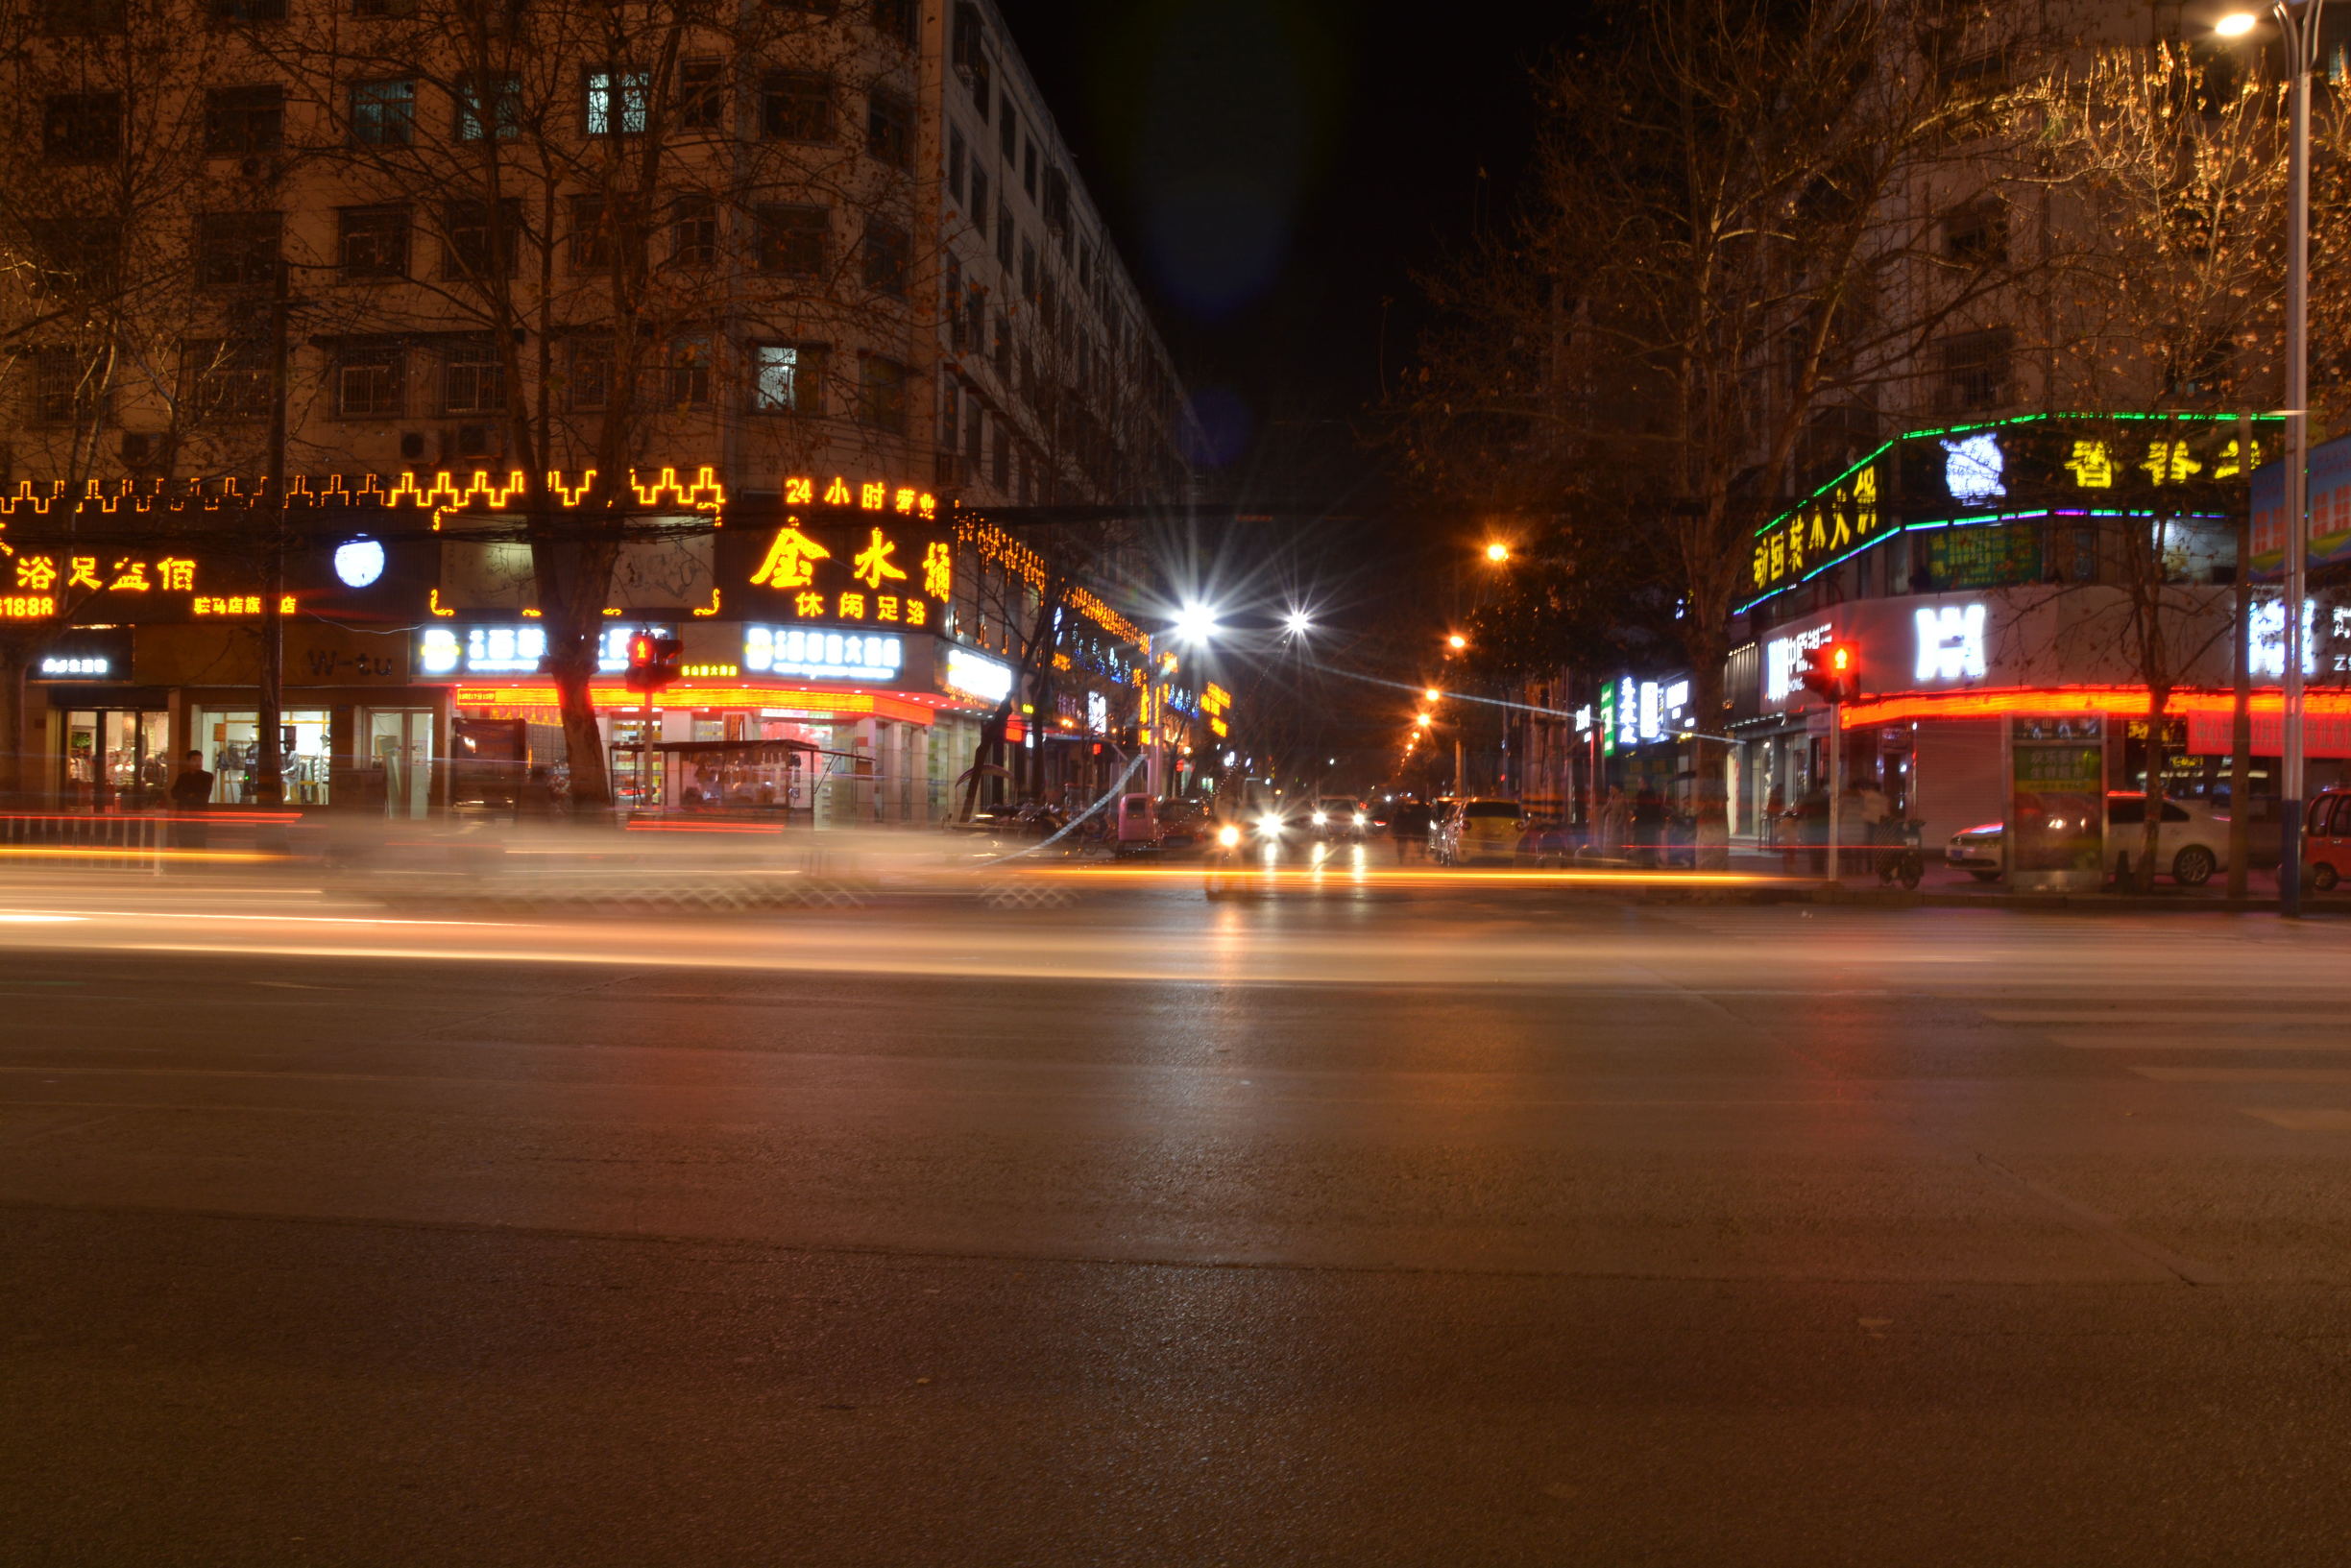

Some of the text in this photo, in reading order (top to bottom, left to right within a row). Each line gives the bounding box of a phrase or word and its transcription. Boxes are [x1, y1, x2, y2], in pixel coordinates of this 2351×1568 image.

[786, 477, 935, 519] 24小时营业
[749, 516, 951, 603] 金水桶
[0, 597, 53, 615] 1888
[194, 596, 296, 615] 驻马店旗店
[795, 591, 926, 625] 休闲足浴
